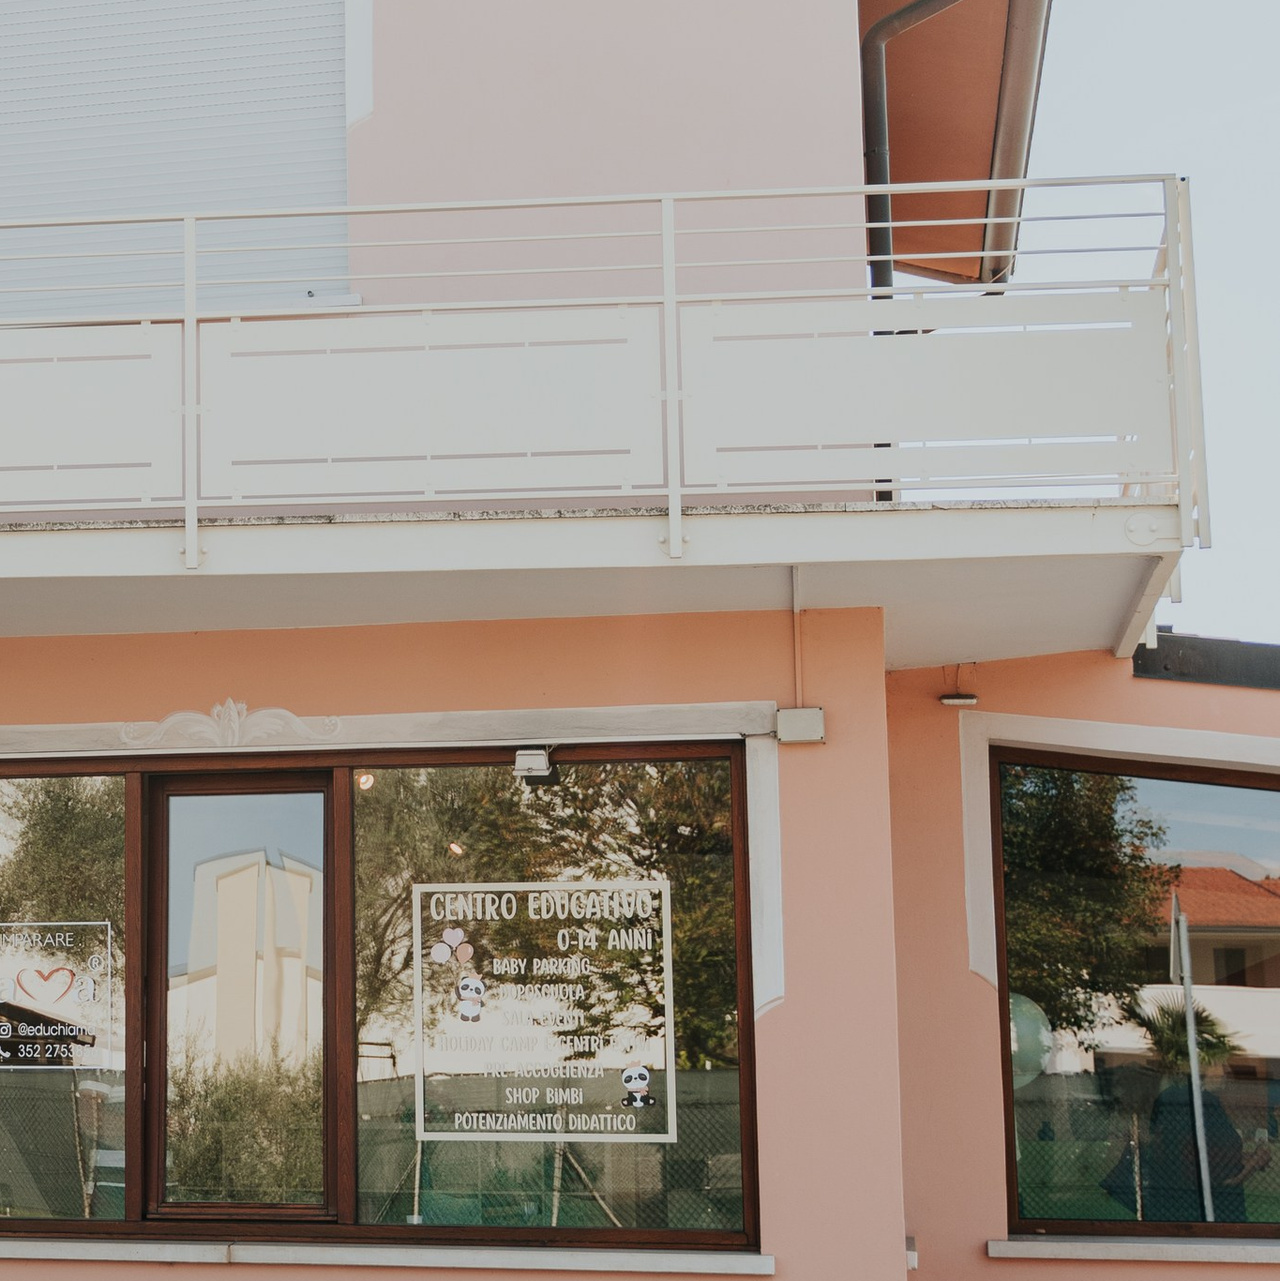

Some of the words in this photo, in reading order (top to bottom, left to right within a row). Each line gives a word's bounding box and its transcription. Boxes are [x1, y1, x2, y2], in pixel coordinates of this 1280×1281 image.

[430, 893, 517, 920] CENTRO
[528, 892, 653, 920] EDUCATIVO
[0, 932, 74, 947] IMPARARE
[557, 929, 599, 951] 0-14
[492, 958, 527, 975] BABY
[500, 983, 586, 1000] DOPOSCUOLA
[503, 1010, 533, 1027] SALA
[17, 1022, 96, 1037] @educhiama
[17, 1044, 41, 1058] 352
[502, 1035, 539, 1052] CAMP
[483, 1061, 509, 1078] PRE
[505, 1087, 540, 1104] SHOP
